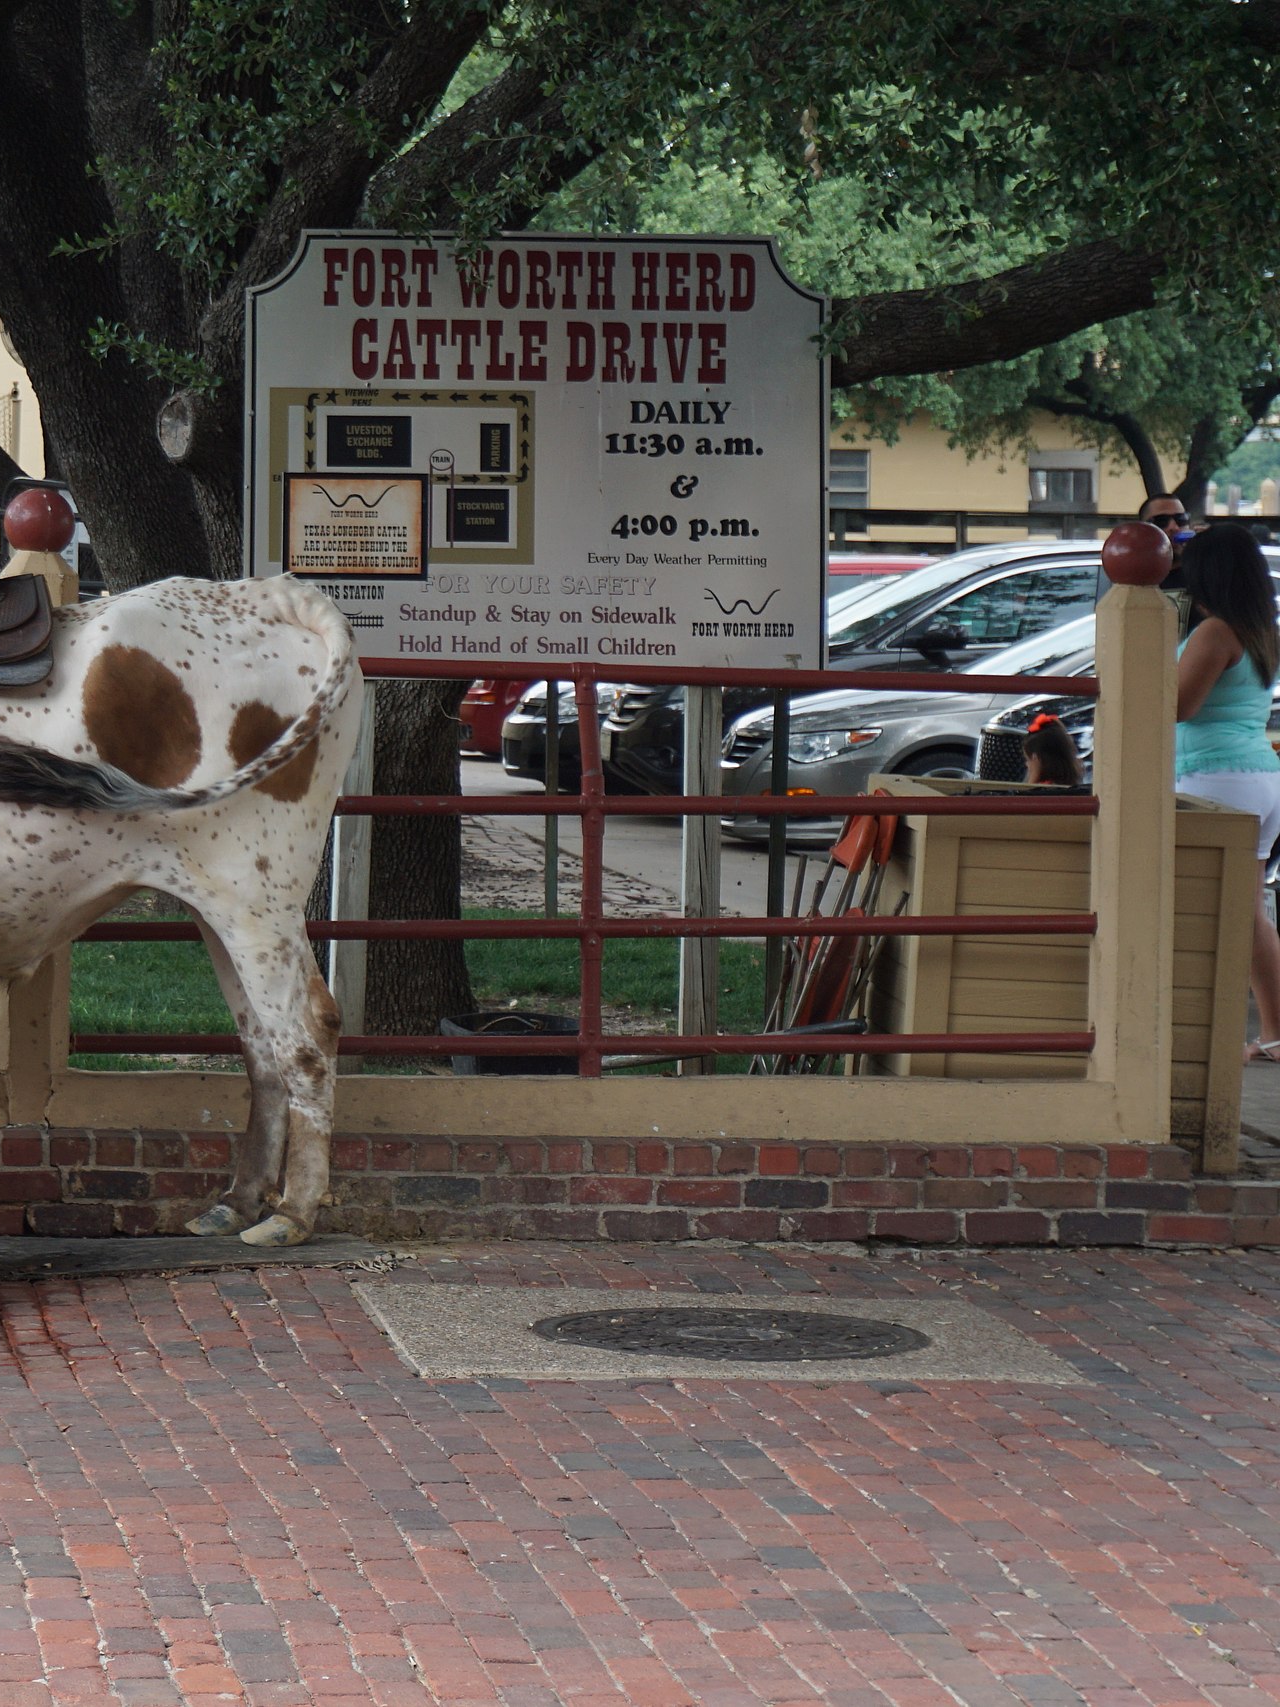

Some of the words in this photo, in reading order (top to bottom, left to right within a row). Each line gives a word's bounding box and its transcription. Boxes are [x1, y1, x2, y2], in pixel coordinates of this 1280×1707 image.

[324, 248, 438, 308] FORT
[455, 249, 616, 310] WORTH
[631, 252, 756, 312] HERD
[352, 318, 548, 382] CATTLE
[566, 321, 727, 384] DRIVE
[344, 388, 379, 398] VIEWING
[351, 398, 373, 407] PENS
[630, 400, 732, 425] DAILY
[346, 425, 393, 435] LIVESTOCK
[347, 437, 393, 447] EXCHANGE
[490, 429, 501, 468] PARKING
[605, 433, 685, 458] 11:30
[695, 436, 764, 456] a.m.
[356, 448, 383, 459] BLDG.
[431, 456, 451, 464] TRAIN
[670, 474, 700, 499] &
[457, 502, 505, 511] STOCKYARDS
[330, 510, 344, 518] FORT
[345, 510, 363, 519] WORTH
[364, 511, 378, 519] HERD
[465, 517, 496, 526] STATION
[304, 525, 330, 537] TEXAS
[332, 525, 375, 538] LONGHORN
[377, 525, 408, 538] CATTLE
[611, 514, 678, 539] 4:00
[688, 517, 760, 542] p.m.
[303, 540, 321, 552] ARE
[323, 541, 358, 553] LOCATED
[360, 541, 390, 553] BEHIND
[392, 541, 408, 553] THE
[291, 555, 335, 567] LIVESTOCK
[337, 556, 380, 568] EXCHANGE
[382, 556, 419, 569] BUILDING
[587, 552, 621, 567] Every
[625, 553, 649, 567] Day
[653, 553, 702, 566] Weather
[708, 554, 768, 568] Permitting
[343, 585, 385, 600] STATION
[421, 575, 470, 594] FOR
[485, 575, 551, 595] YOUR
[560, 575, 657, 596] SAFETY
[399, 603, 477, 626] Standup
[485, 604, 502, 623] &
[511, 604, 551, 627] Stay
[559, 610, 583, 624] on
[591, 605, 677, 625] Sidewalk
[692, 622, 719, 637] FORT
[722, 622, 761, 638] WORTH
[764, 623, 795, 638] HERD
[399, 635, 442, 653] Hold
[451, 635, 502, 654] Hand
[510, 635, 529, 654] of
[537, 636, 589, 655] Small
[597, 637, 677, 656] Children
